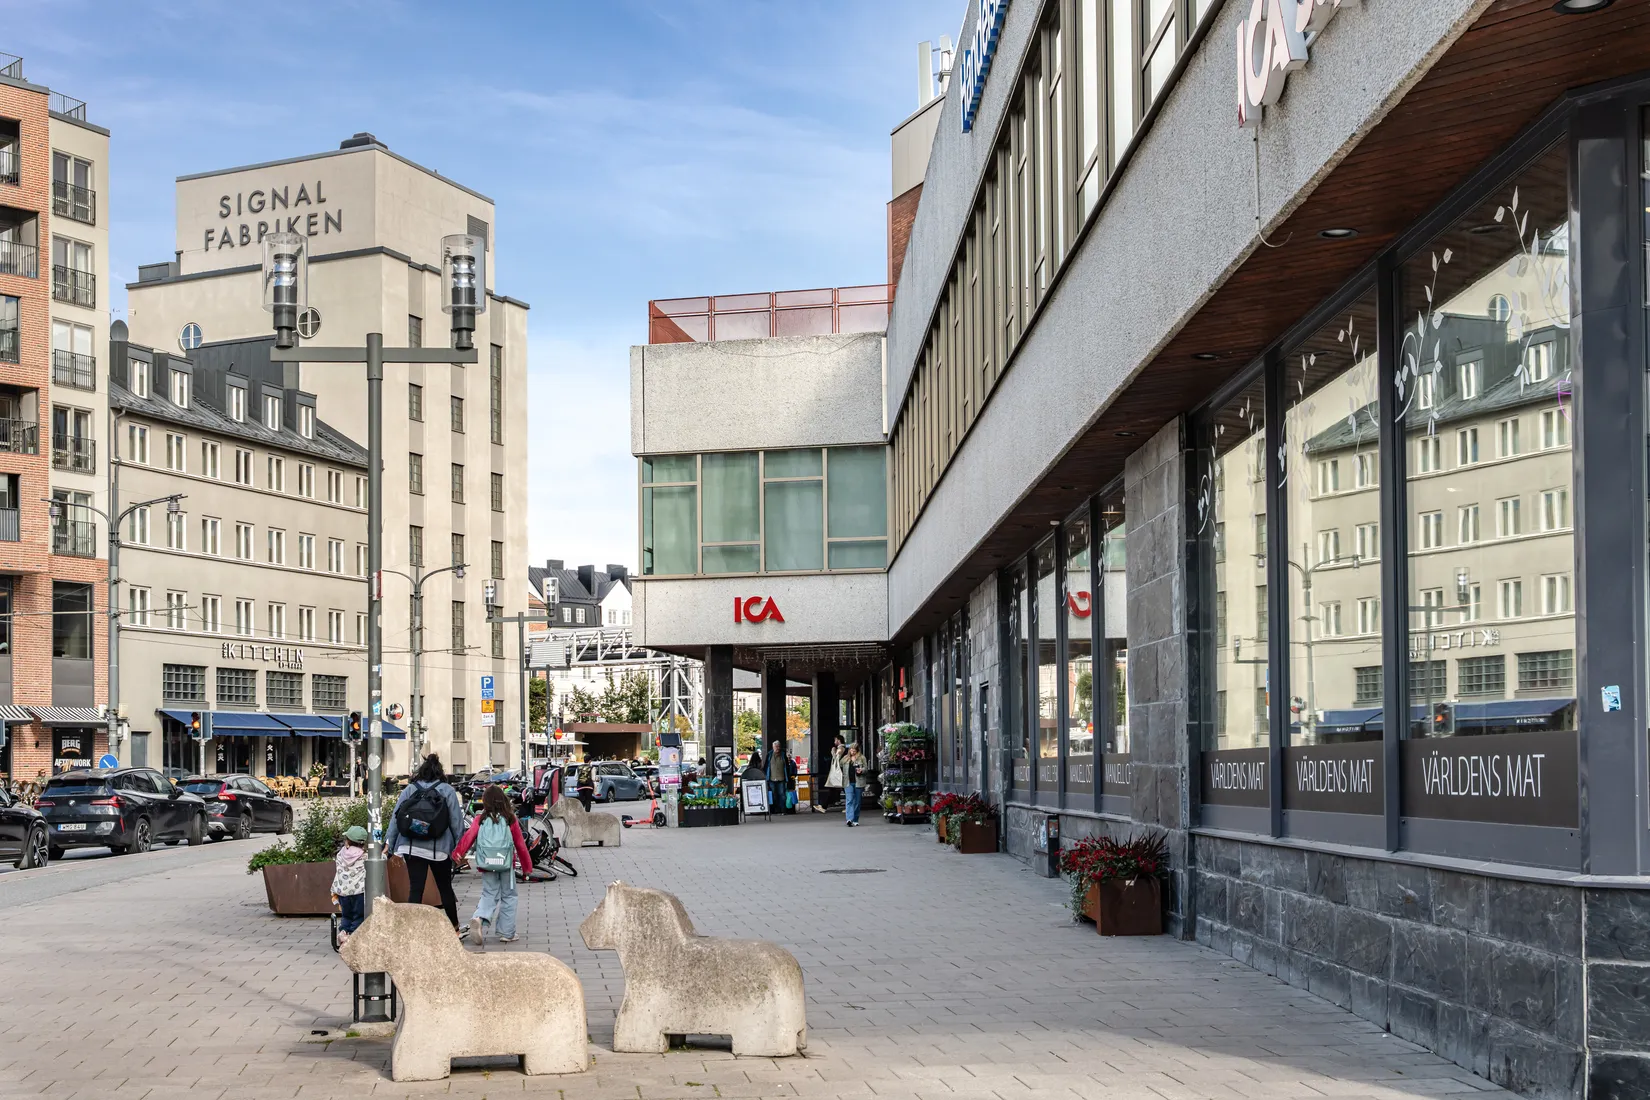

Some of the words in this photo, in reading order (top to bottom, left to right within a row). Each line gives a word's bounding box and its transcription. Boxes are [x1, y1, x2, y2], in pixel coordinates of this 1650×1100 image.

[219, 180, 327, 218] SIGNAL
[204, 209, 342, 252] FABRIKEN
[734, 596, 785, 623] ICA
[228, 643, 304, 663] KITCHIN
[483, 677, 492, 689] P
[62, 739, 80, 750] BERG
[73, 758, 92, 767] WORK
[1211, 759, 1247, 790] VÄRLDENS
[1248, 762, 1265, 790] MAT
[1296, 755, 1348, 793] VÄRLDENS
[1349, 759, 1375, 793] MAT
[1422, 750, 1501, 797] VÄRLDENS
[1506, 754, 1545, 797] MAT
